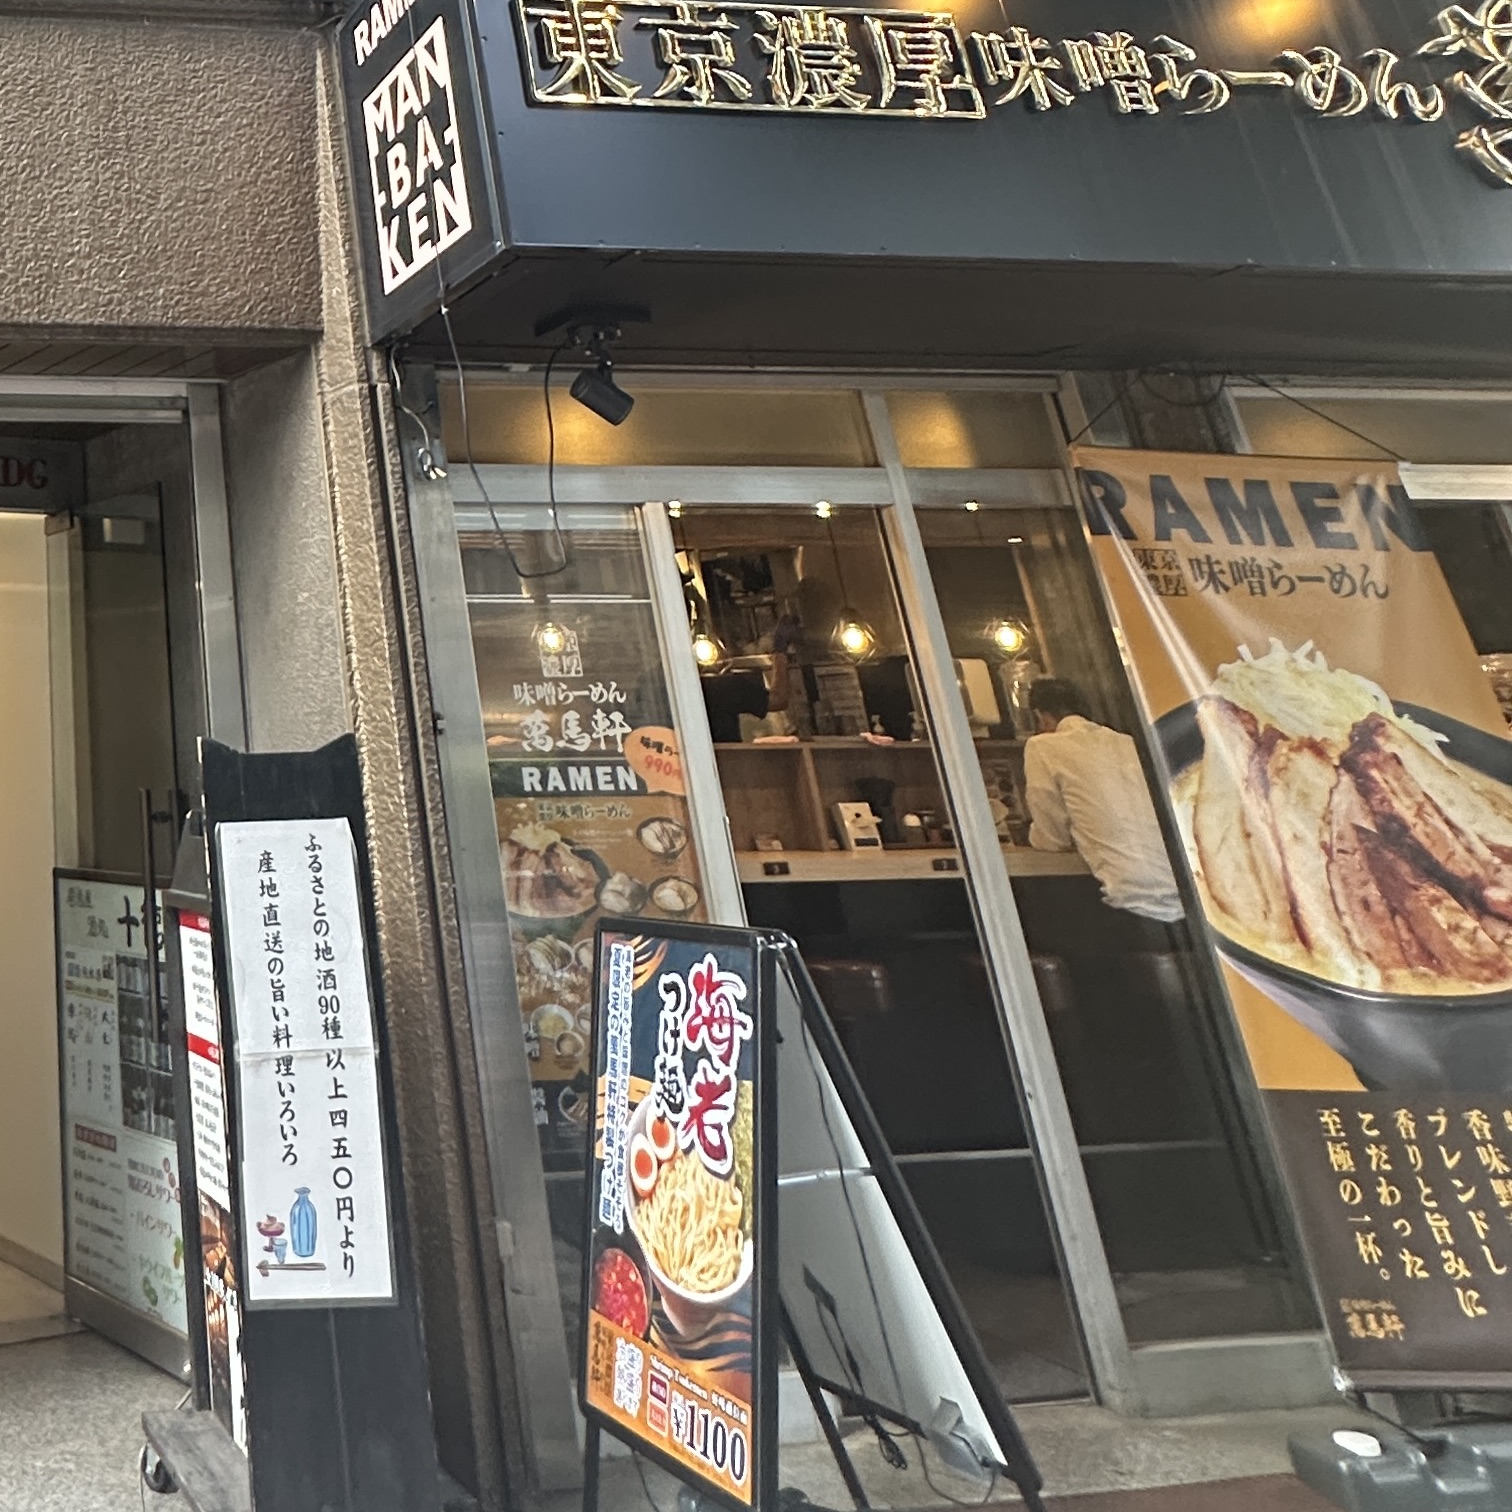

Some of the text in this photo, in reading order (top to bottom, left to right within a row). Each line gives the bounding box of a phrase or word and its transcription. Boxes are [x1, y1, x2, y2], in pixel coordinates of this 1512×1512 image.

[363, 15, 447, 157] MAN
[377, 165, 472, 295] KEN
[1079, 467, 1435, 553] RAMEN
[1188, 555, 1390, 599] 味噌らーめん
[513, 682, 626, 705] 味噌らーめん
[522, 767, 638, 792] RAMEN
[257, 849, 298, 1166] 産地直送の旨い料理いろいろ
[682, 961, 749, 1163] 海老
[1357, 1111, 1430, 1279] こだわった
[1393, 1108, 1488, 1317] 香りと旨みに
[1461, 1108, 1512, 1227] 香味野
